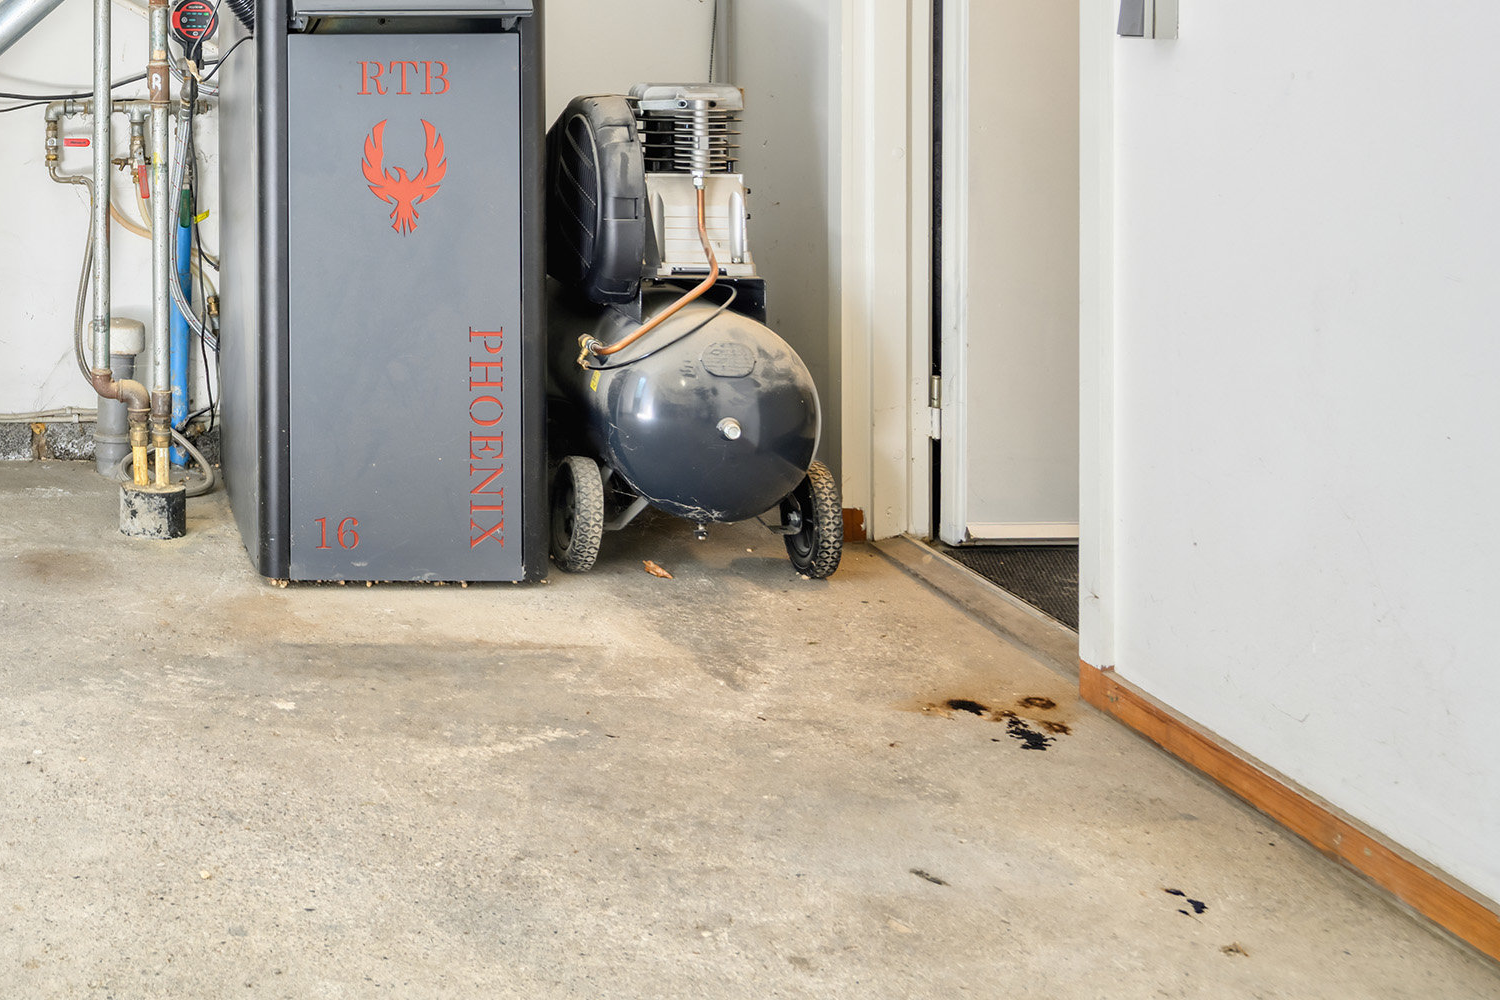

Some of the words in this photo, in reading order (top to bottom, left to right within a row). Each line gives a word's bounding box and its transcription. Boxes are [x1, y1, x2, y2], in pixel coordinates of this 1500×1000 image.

[357, 61, 451, 95] RTB
[469, 326, 504, 549] PHOENIX
[314, 516, 360, 549] 16
